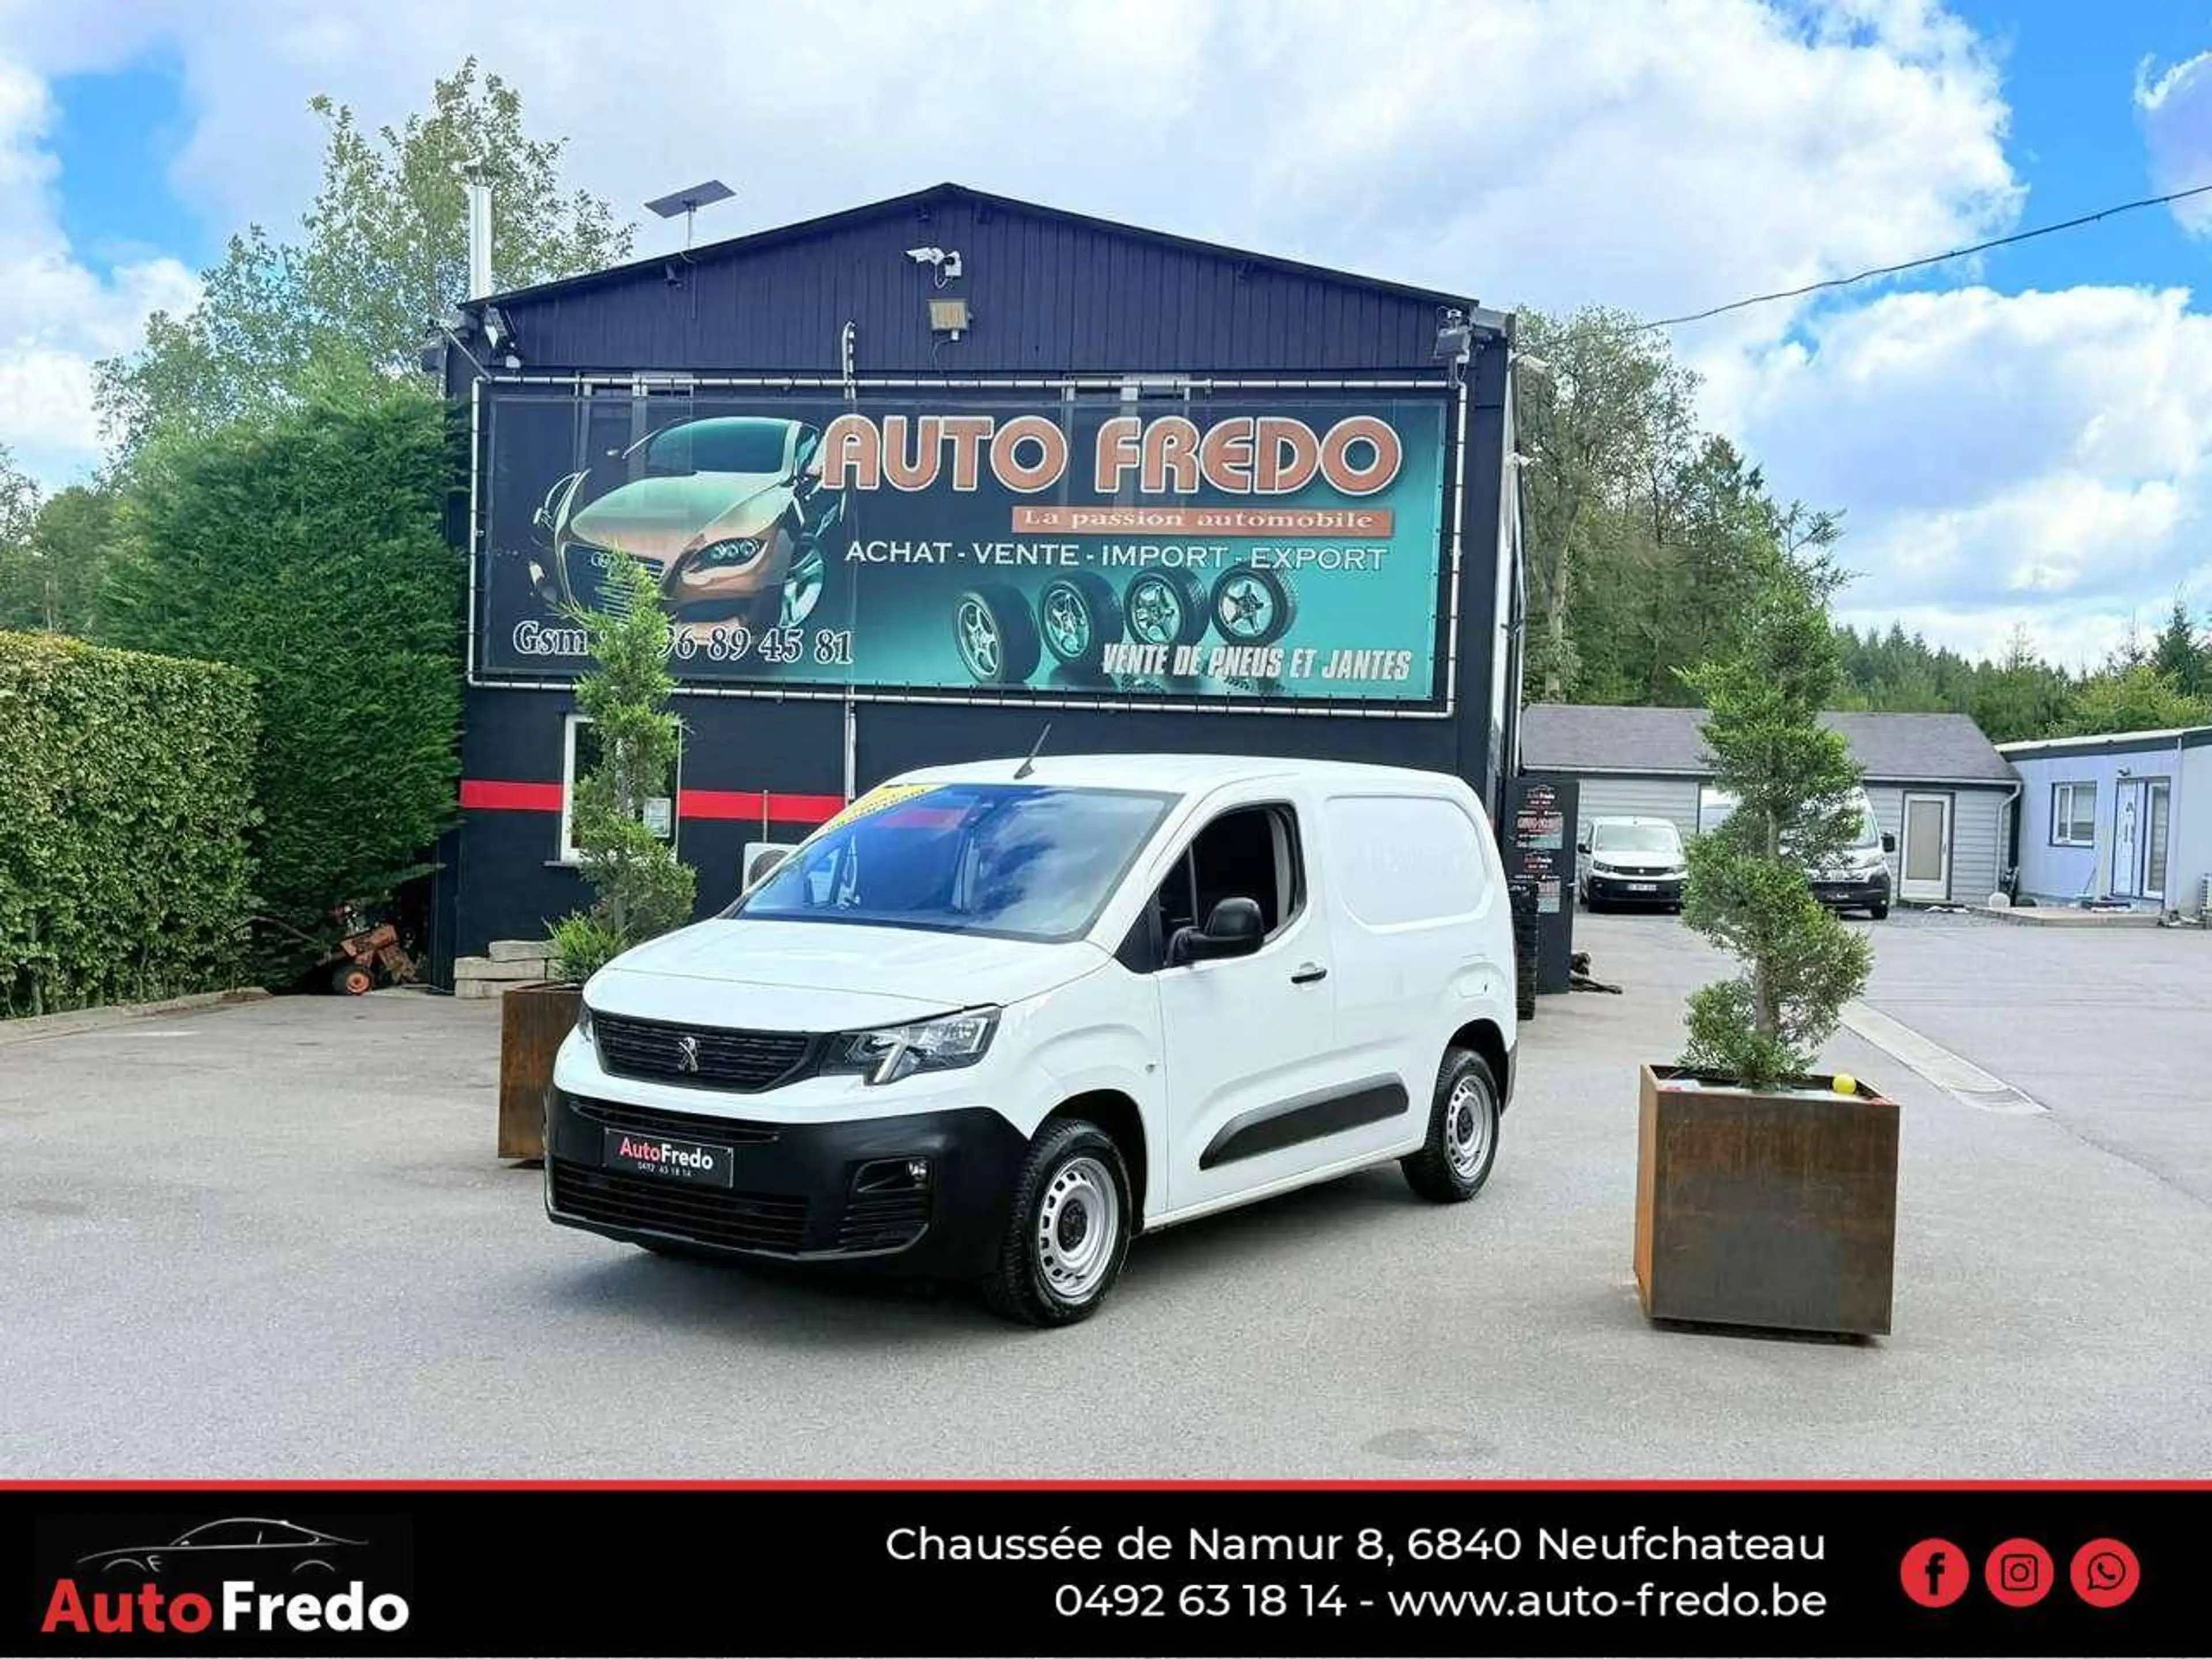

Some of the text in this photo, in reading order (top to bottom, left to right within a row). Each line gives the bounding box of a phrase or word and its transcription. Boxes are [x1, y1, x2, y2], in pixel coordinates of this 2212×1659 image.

[822, 413, 1403, 496] AUTO FREDO
[1025, 508, 1373, 529] La passion automobile
[844, 540, 953, 563] ACHAT
[972, 543, 1080, 565] VENTE
[1101, 545, 1228, 567] IMPORT
[1251, 548, 1388, 570] EXPORT
[513, 620, 589, 655] Gsm
[707, 626, 751, 661] 89
[758, 628, 804, 664] 45
[813, 630, 853, 664] 81
[1103, 643, 1411, 680] VENTE DE PNEUS ET JANTES
[620, 1137, 713, 1169] AutoFredo
